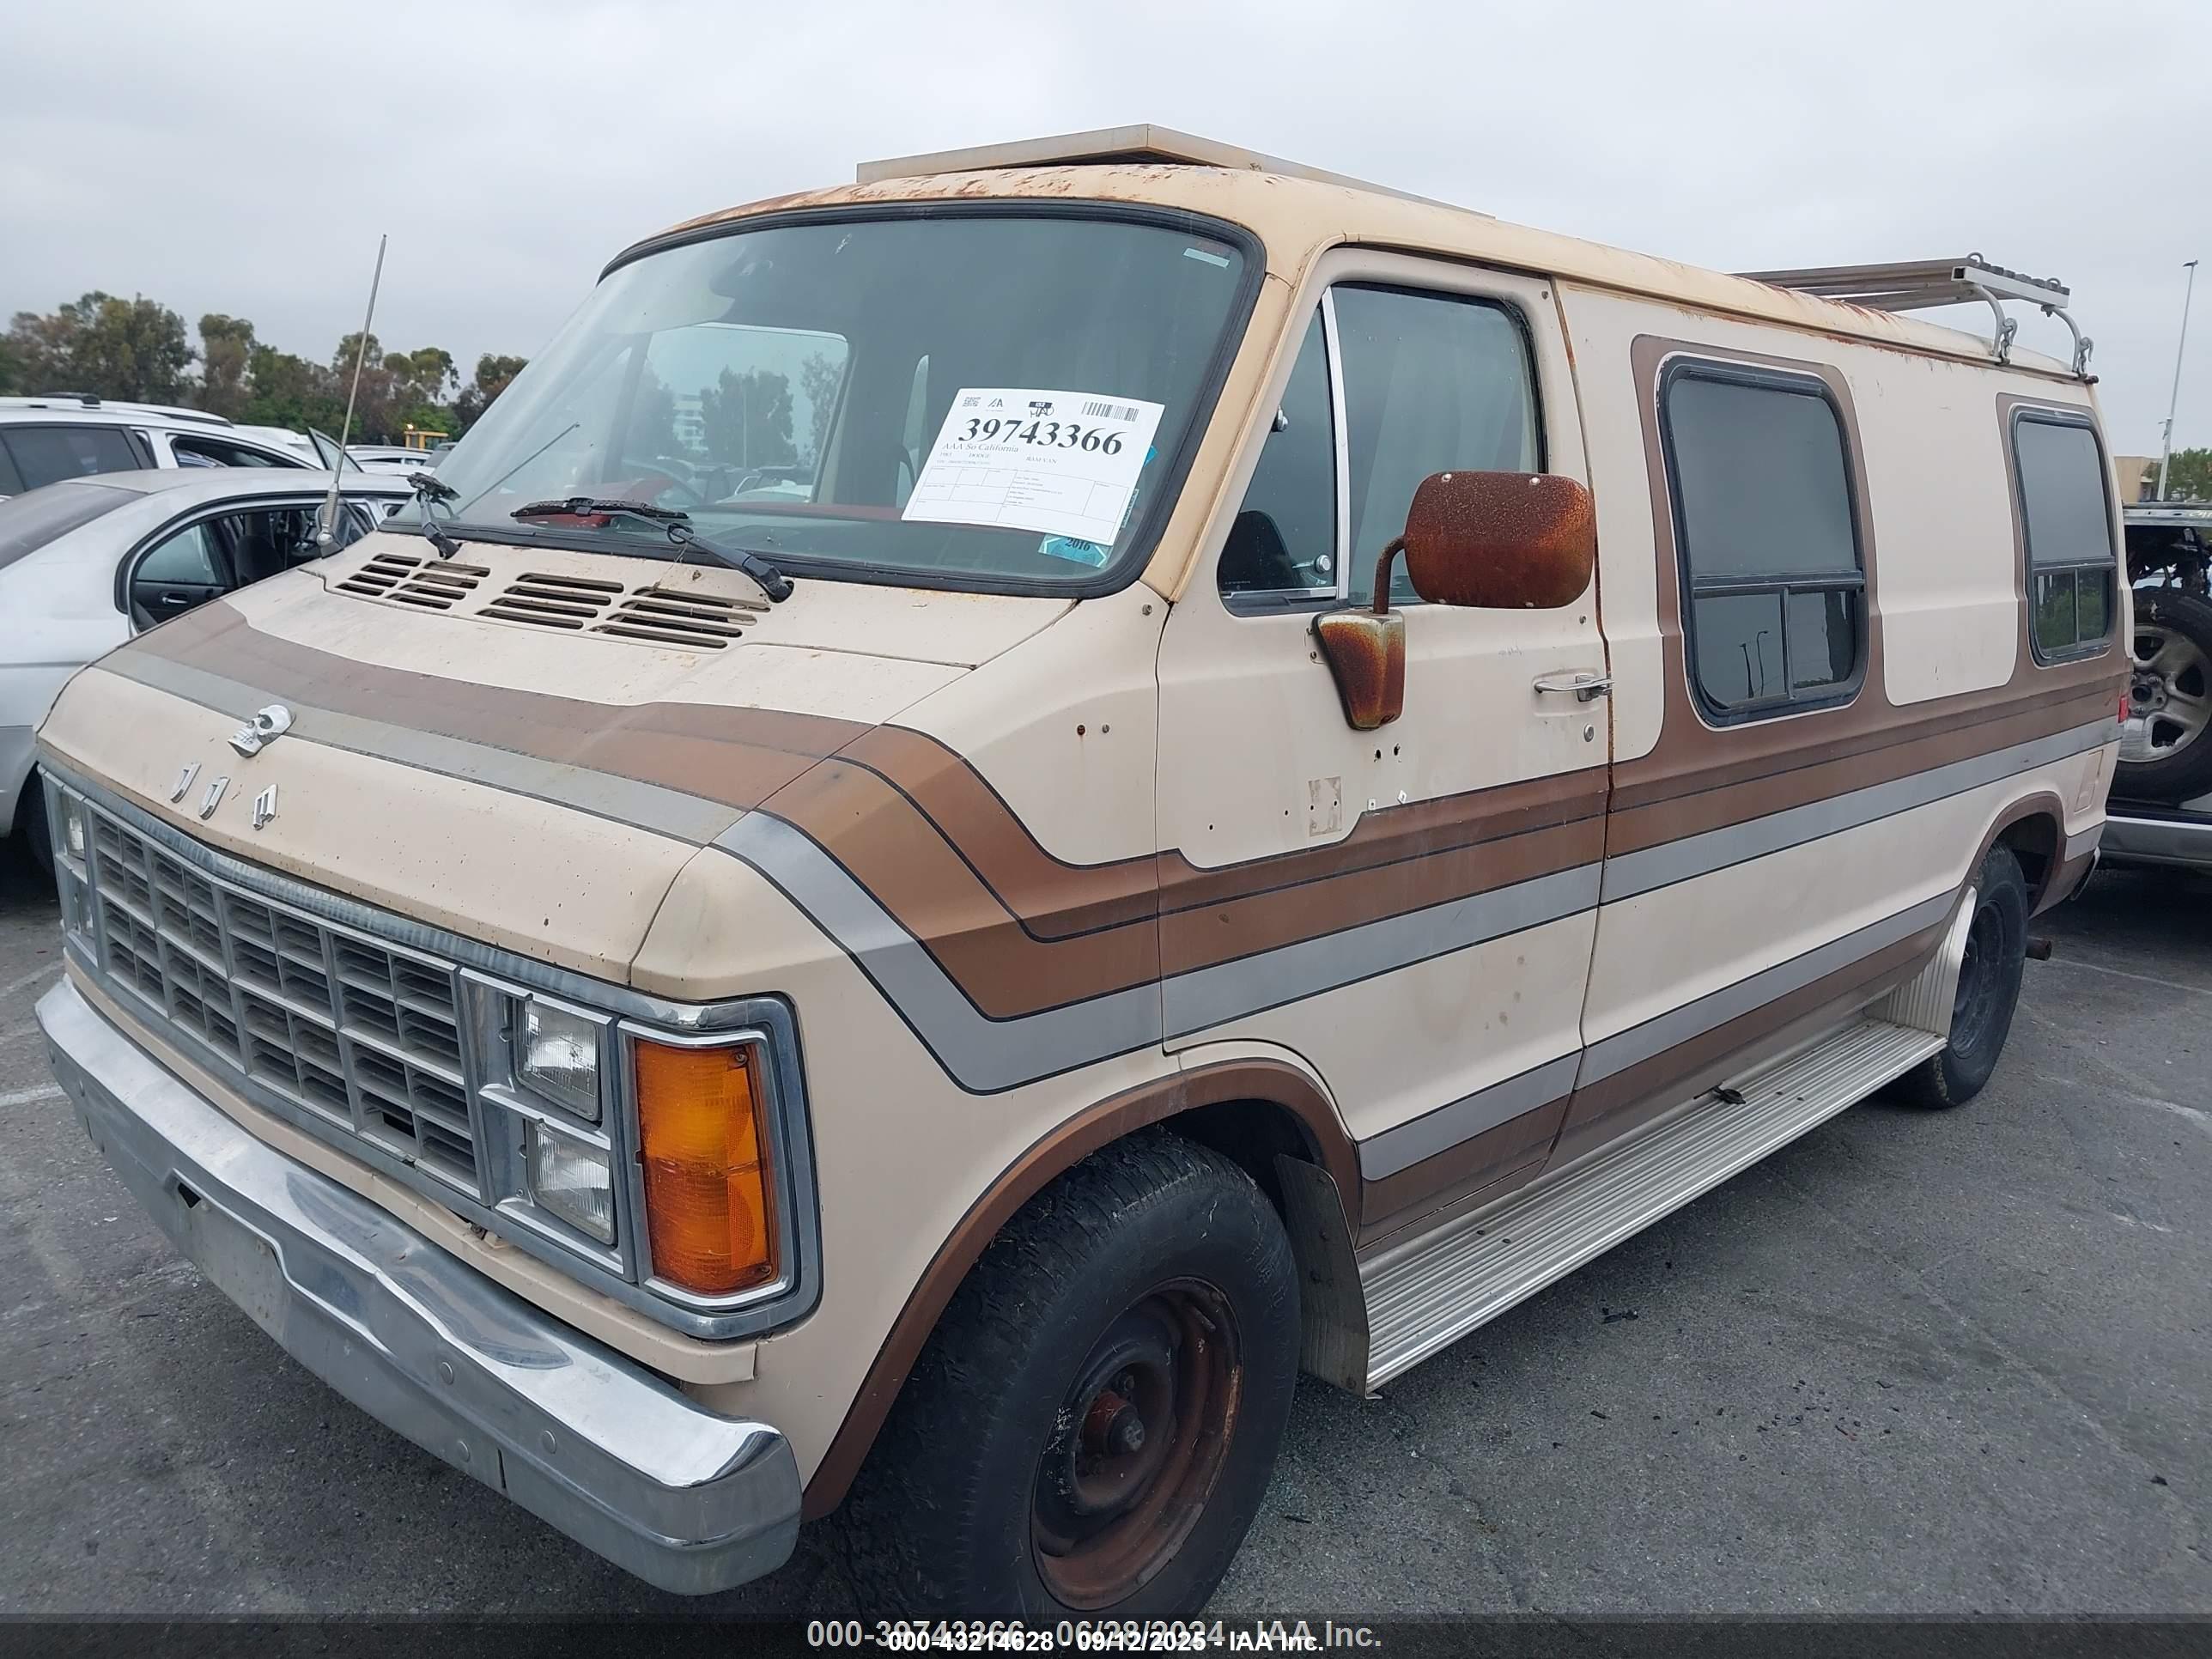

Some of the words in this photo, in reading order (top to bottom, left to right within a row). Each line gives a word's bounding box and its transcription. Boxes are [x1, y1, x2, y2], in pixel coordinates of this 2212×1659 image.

[958, 418, 1127, 455] 39743366
[977, 443, 1018, 453] California
[1065, 538, 1091, 551] 2016
